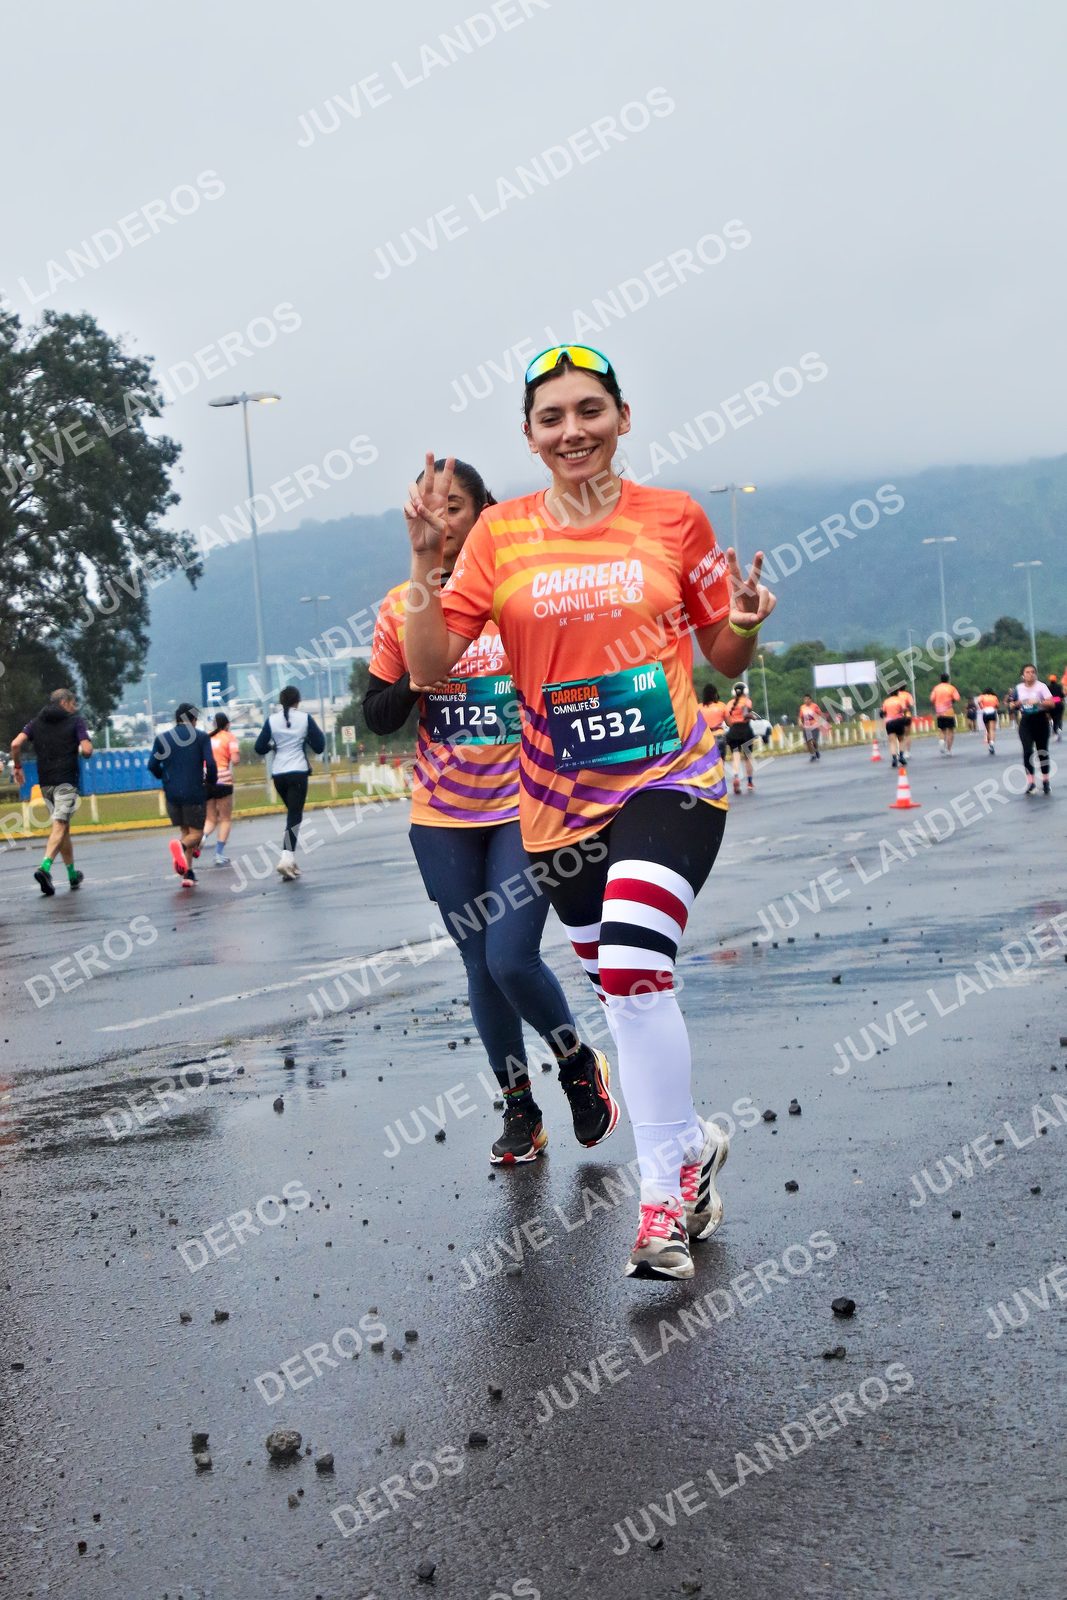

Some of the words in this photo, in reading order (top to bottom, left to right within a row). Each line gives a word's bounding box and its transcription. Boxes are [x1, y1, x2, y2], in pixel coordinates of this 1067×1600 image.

[531, 560, 644, 598] CARRERA
[534, 588, 619, 618] OMNILIFE
[206, 681, 222, 701] E
[494, 680, 512, 695] 10K
[633, 671, 657, 693] 10K
[551, 685, 599, 705] CARRERA
[441, 706, 498, 726] 1125
[553, 702, 589, 715] OMNILIFE
[570, 707, 645, 743] 1532
